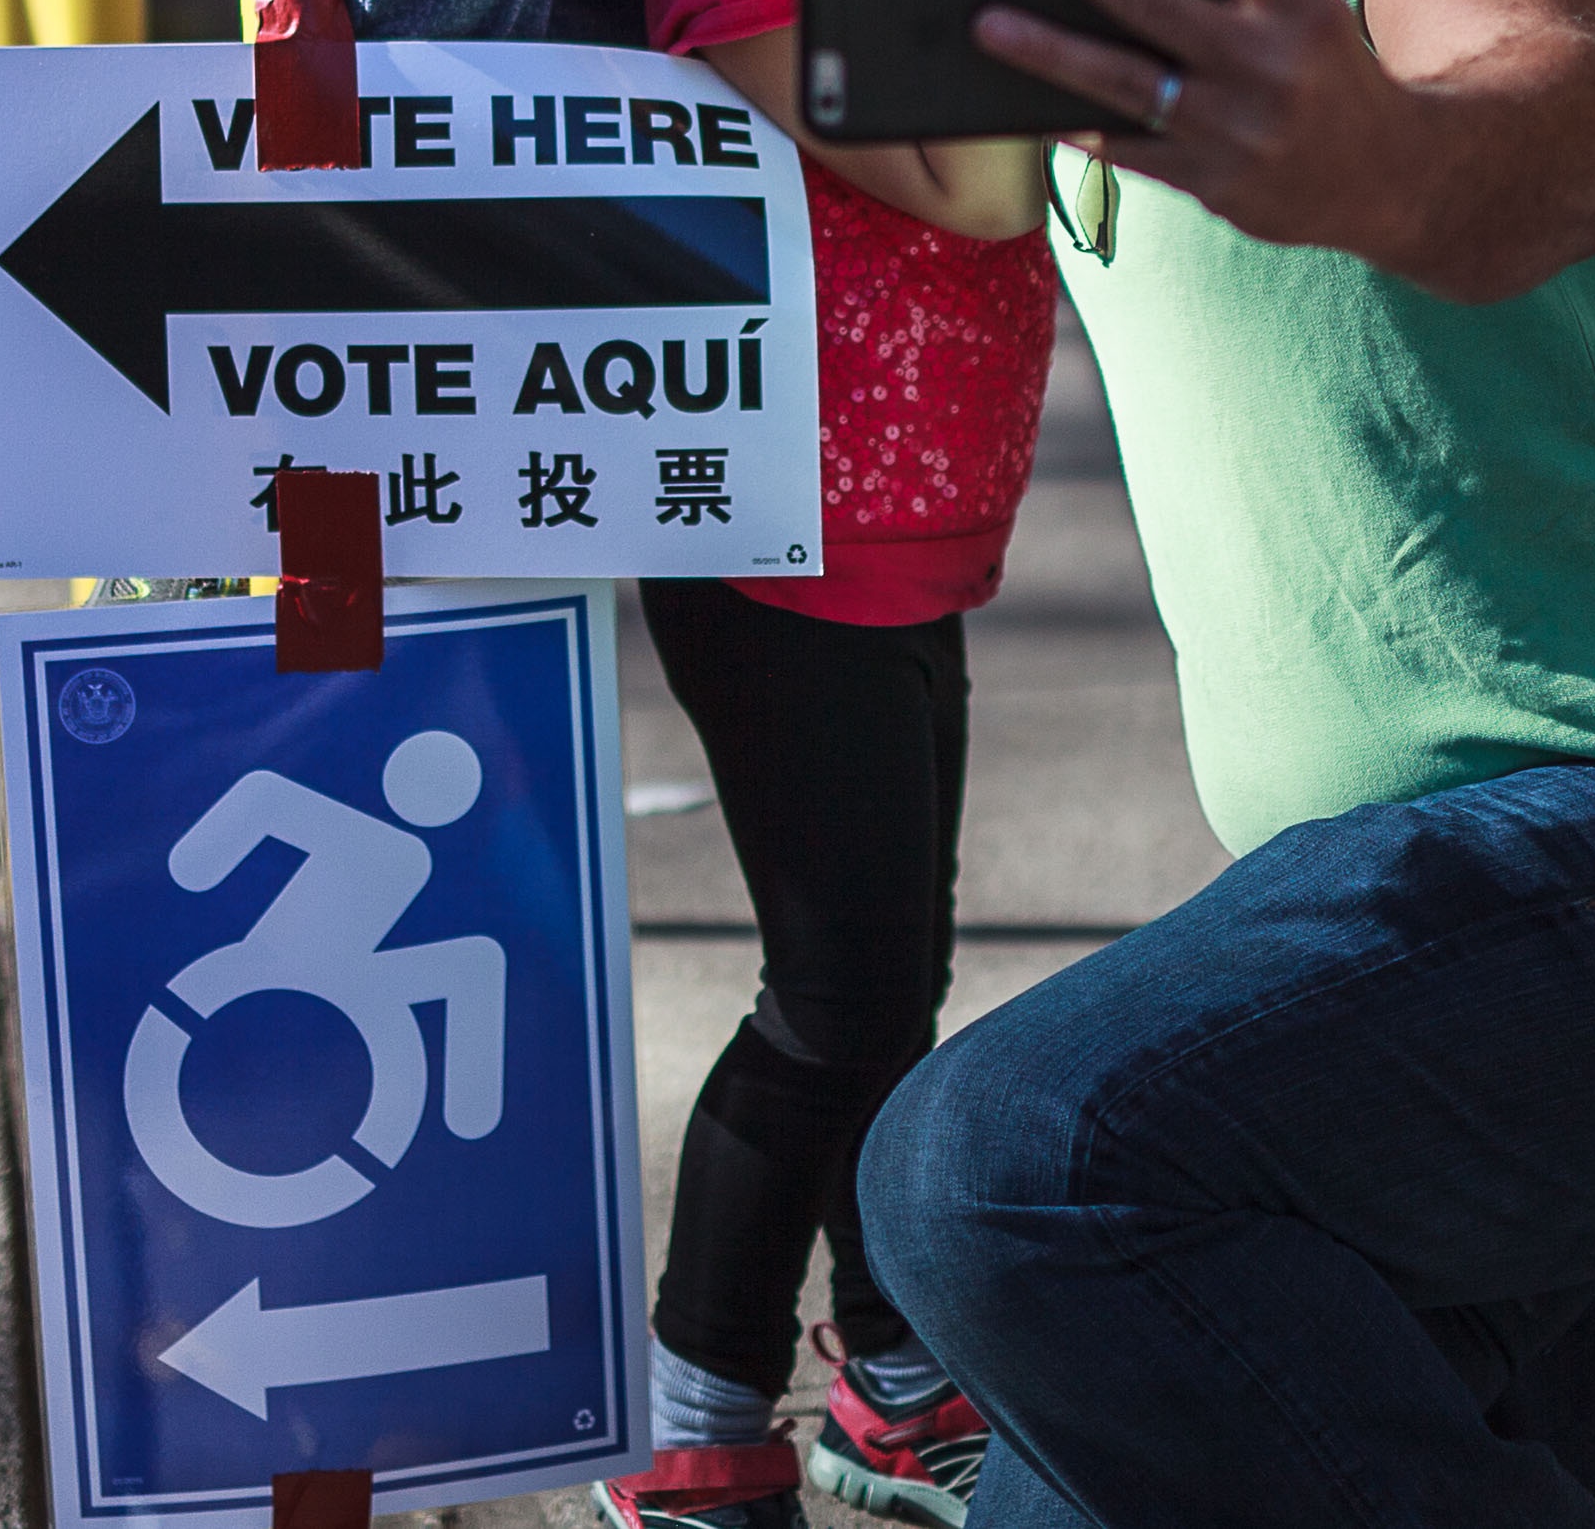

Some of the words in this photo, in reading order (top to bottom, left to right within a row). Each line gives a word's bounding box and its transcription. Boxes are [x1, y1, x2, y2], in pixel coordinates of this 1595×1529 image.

[192, 96, 456, 171] VTE
[491, 95, 760, 169] HERE
[207, 343, 477, 417] VOTE
[513, 318, 769, 420] AQUÍ
